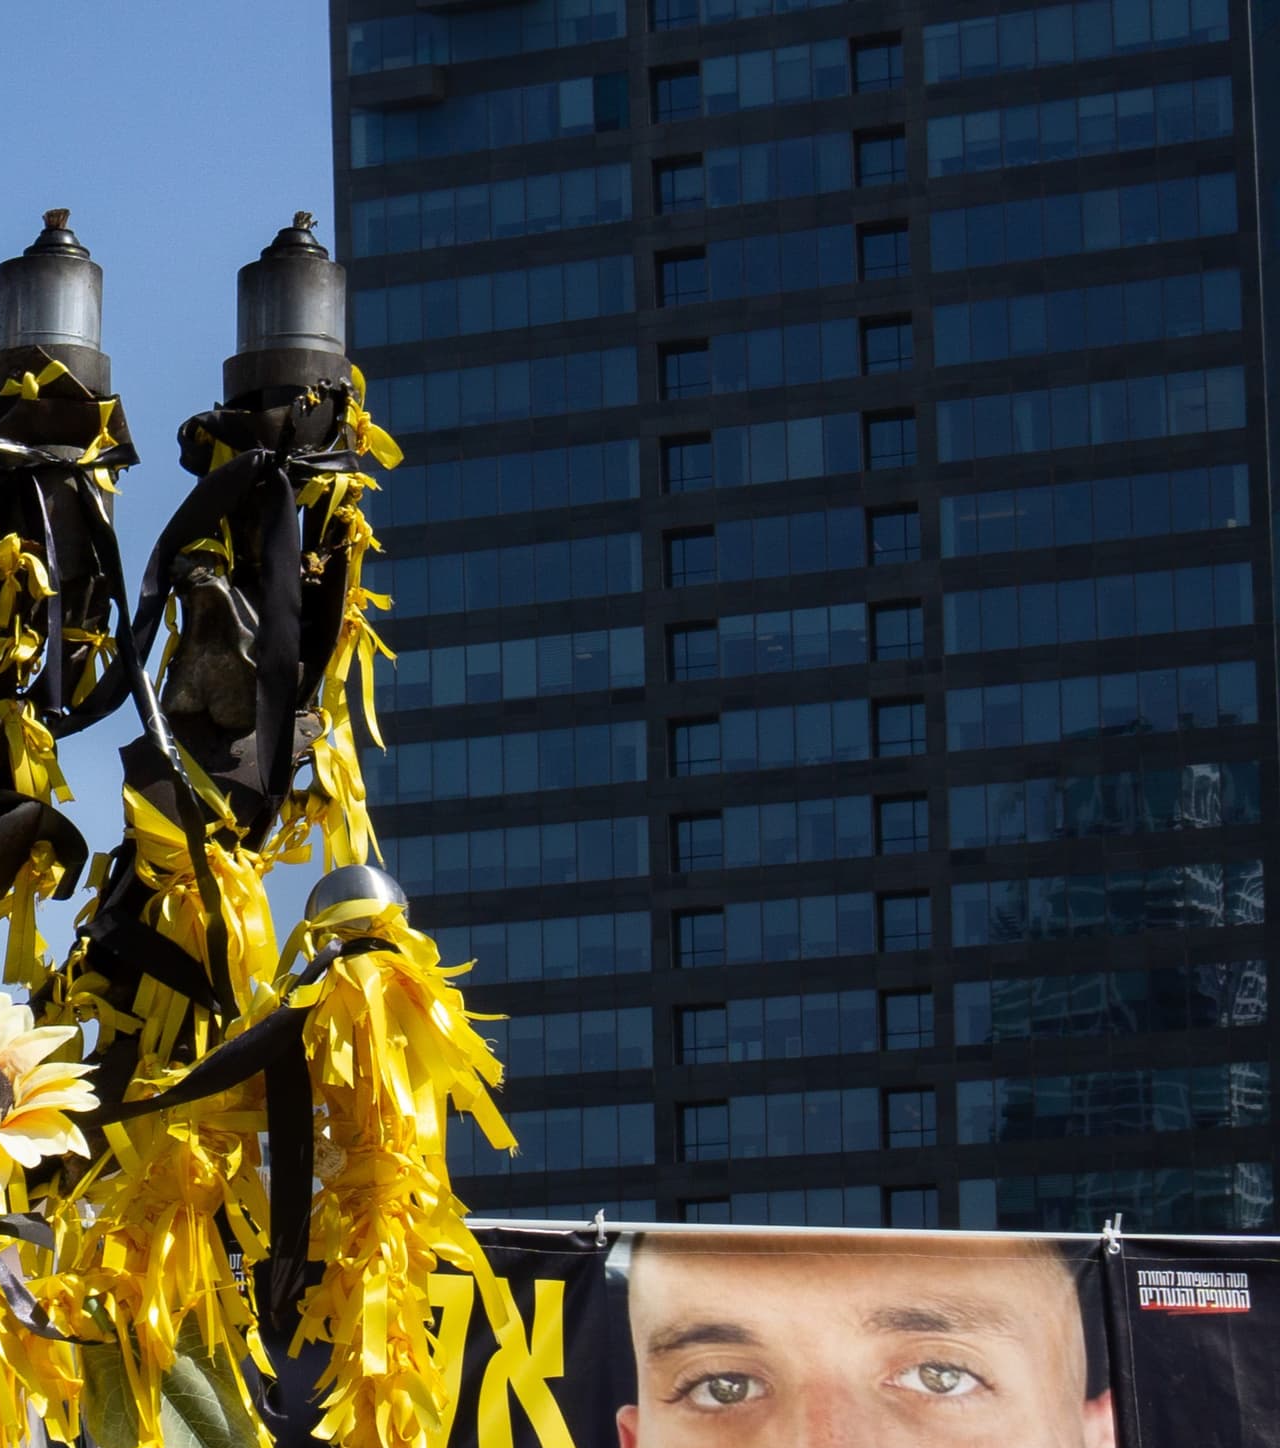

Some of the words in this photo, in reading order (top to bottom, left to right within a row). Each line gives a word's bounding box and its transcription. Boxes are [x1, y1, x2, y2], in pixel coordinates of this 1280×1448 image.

[1137, 1270, 1174, 1286] להחזרת
[1176, 1271, 1224, 1288] המשפחות
[1226, 1272, 1248, 1288] מטה
[1140, 1287, 1195, 1307] והנעדרים
[1196, 1288, 1251, 1308] החטופים
